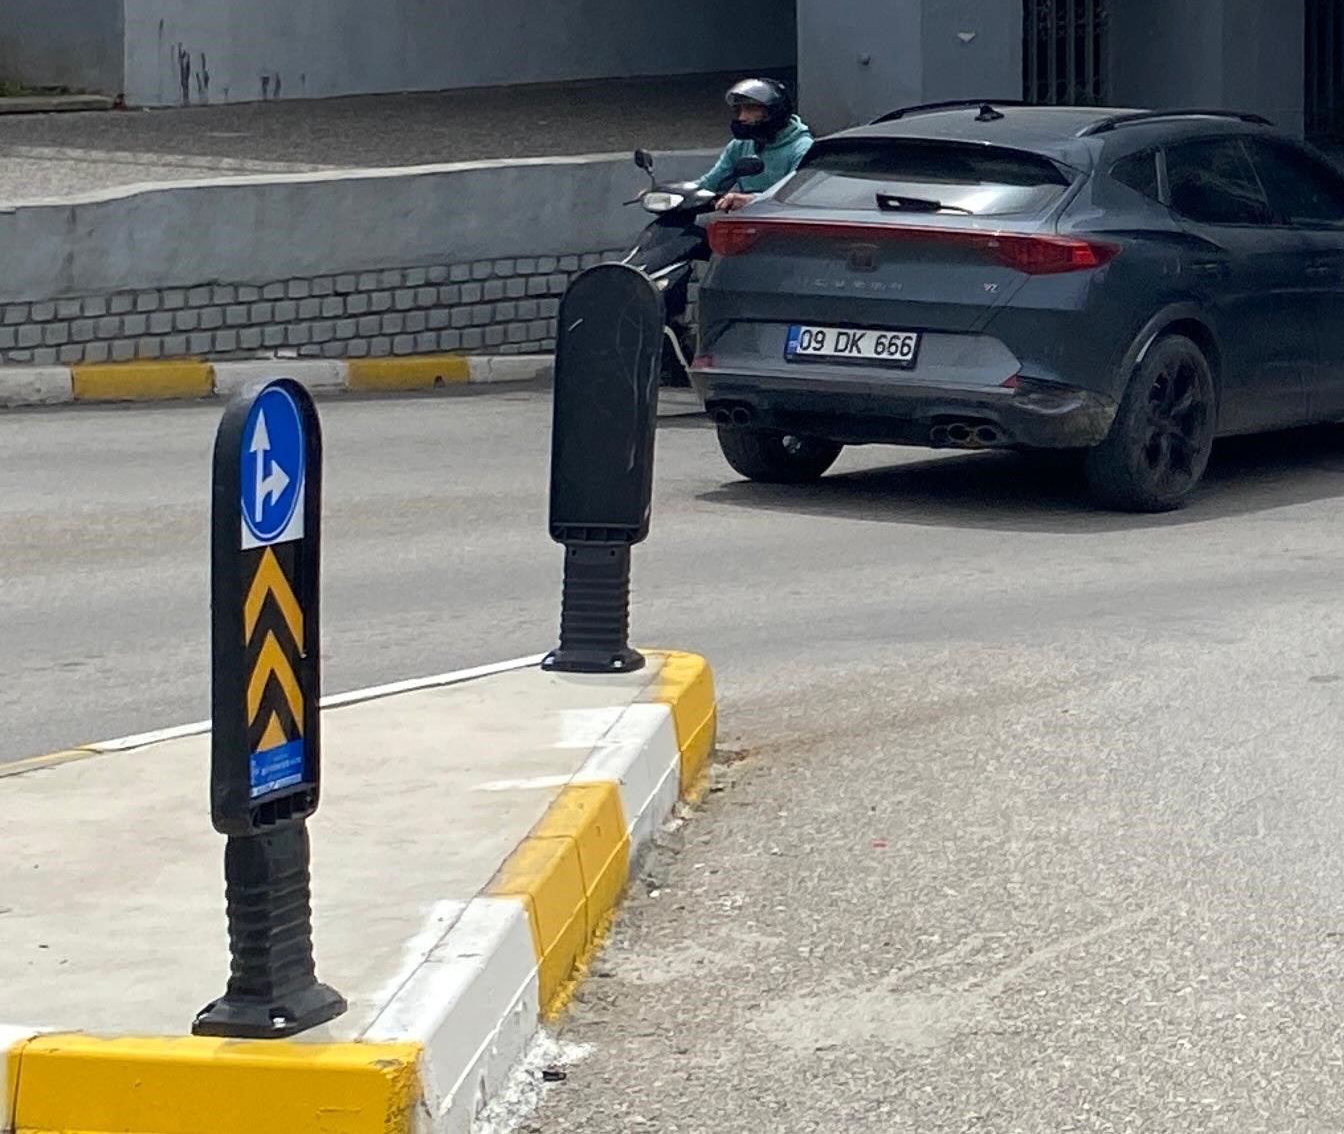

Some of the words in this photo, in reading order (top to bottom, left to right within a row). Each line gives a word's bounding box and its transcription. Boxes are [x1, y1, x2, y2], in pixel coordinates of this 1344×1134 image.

[800, 329, 826, 352] 09
[834, 331, 867, 355] DK
[874, 334, 914, 357] 666
